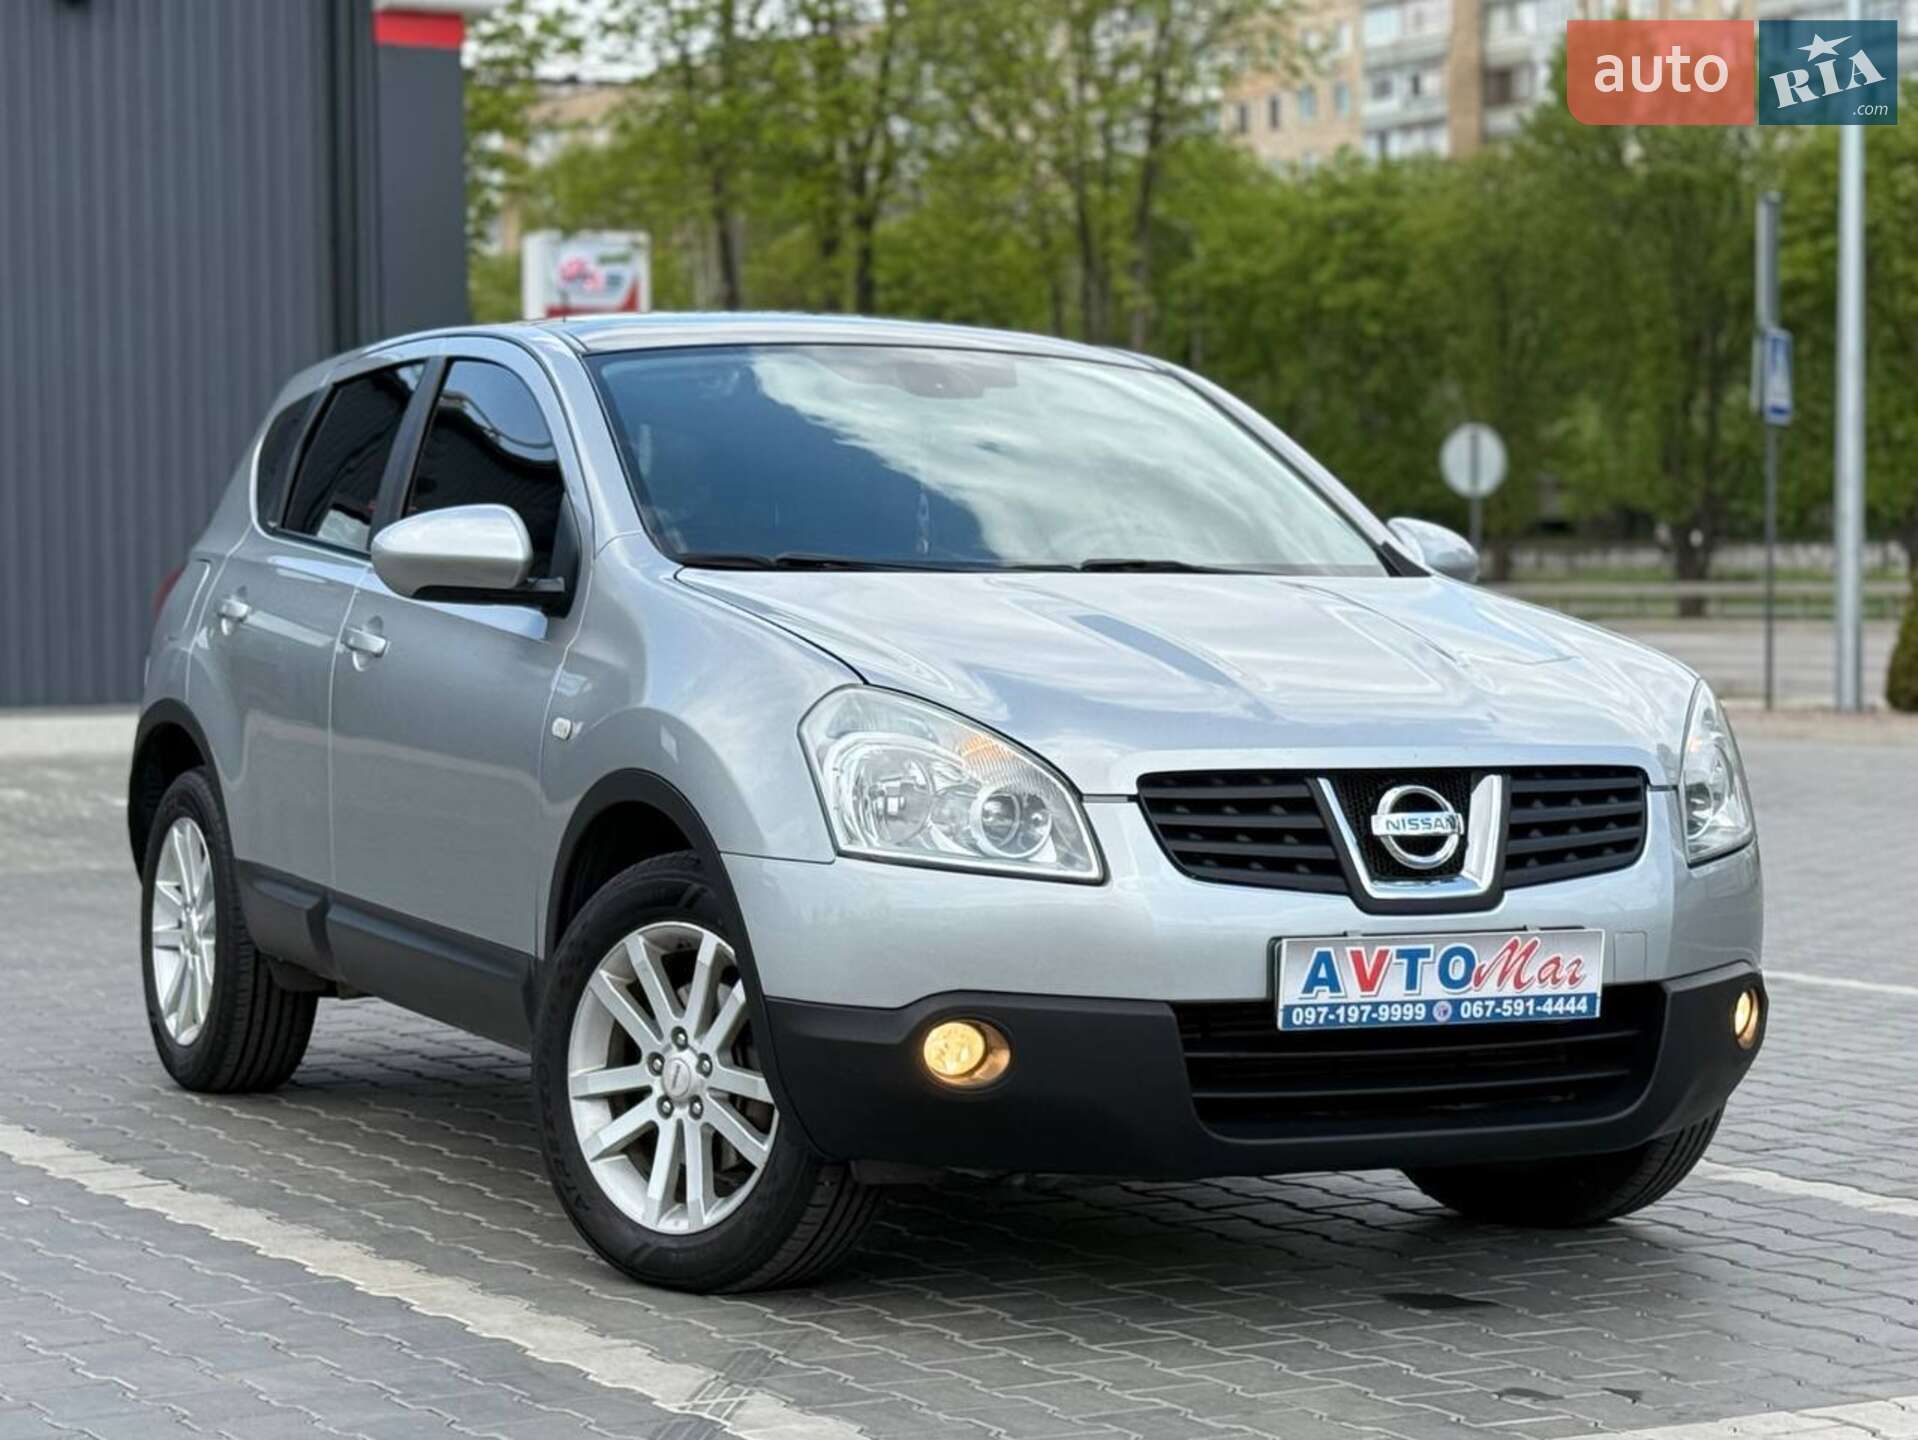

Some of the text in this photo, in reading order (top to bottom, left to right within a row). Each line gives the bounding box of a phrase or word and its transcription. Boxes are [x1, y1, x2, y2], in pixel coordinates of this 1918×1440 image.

[1386, 816, 1457, 832] NISSAN
[1291, 996, 1589, 1025] 097-197-9999 067-591-4444
